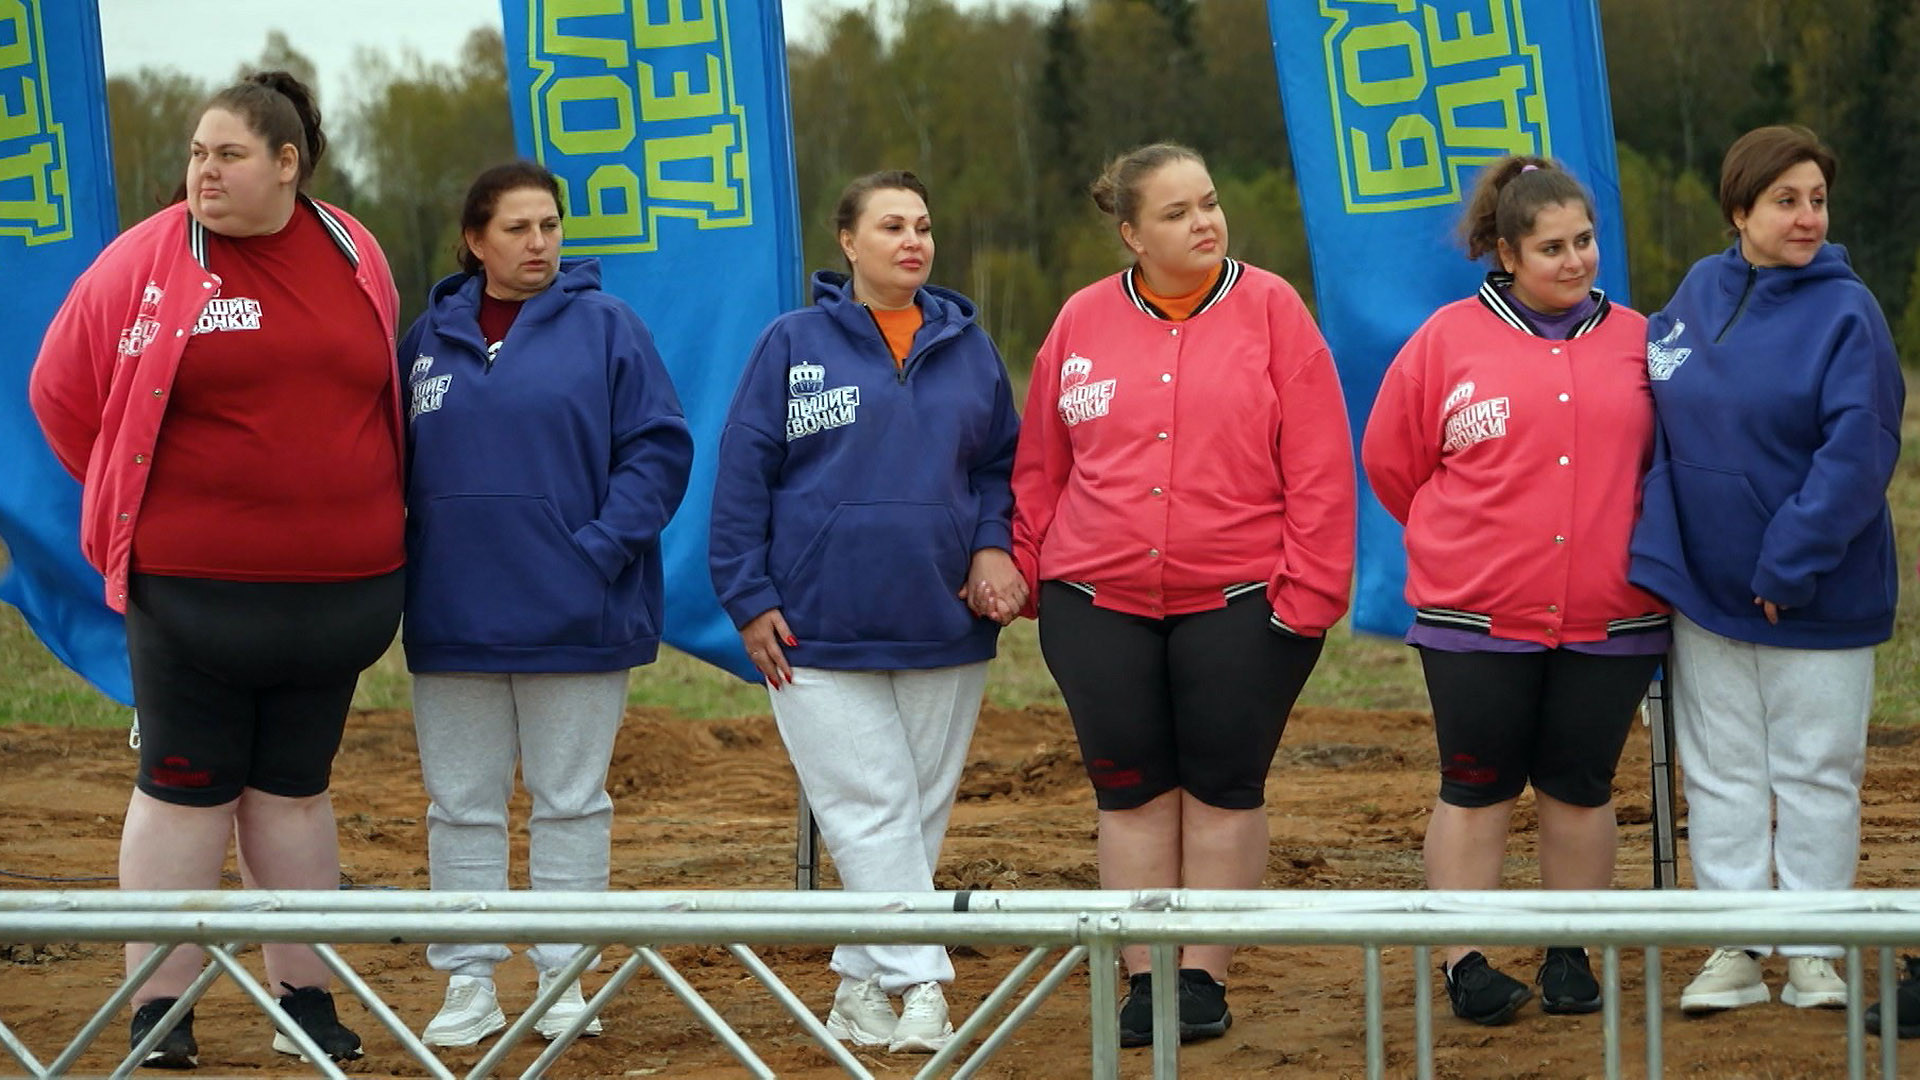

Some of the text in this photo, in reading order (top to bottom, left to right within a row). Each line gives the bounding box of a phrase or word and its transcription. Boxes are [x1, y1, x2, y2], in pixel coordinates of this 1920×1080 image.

[1338, 0, 1445, 195] БО
[203, 299, 260, 317] ШИЕ
[194, 314, 259, 333] ОЧКИ
